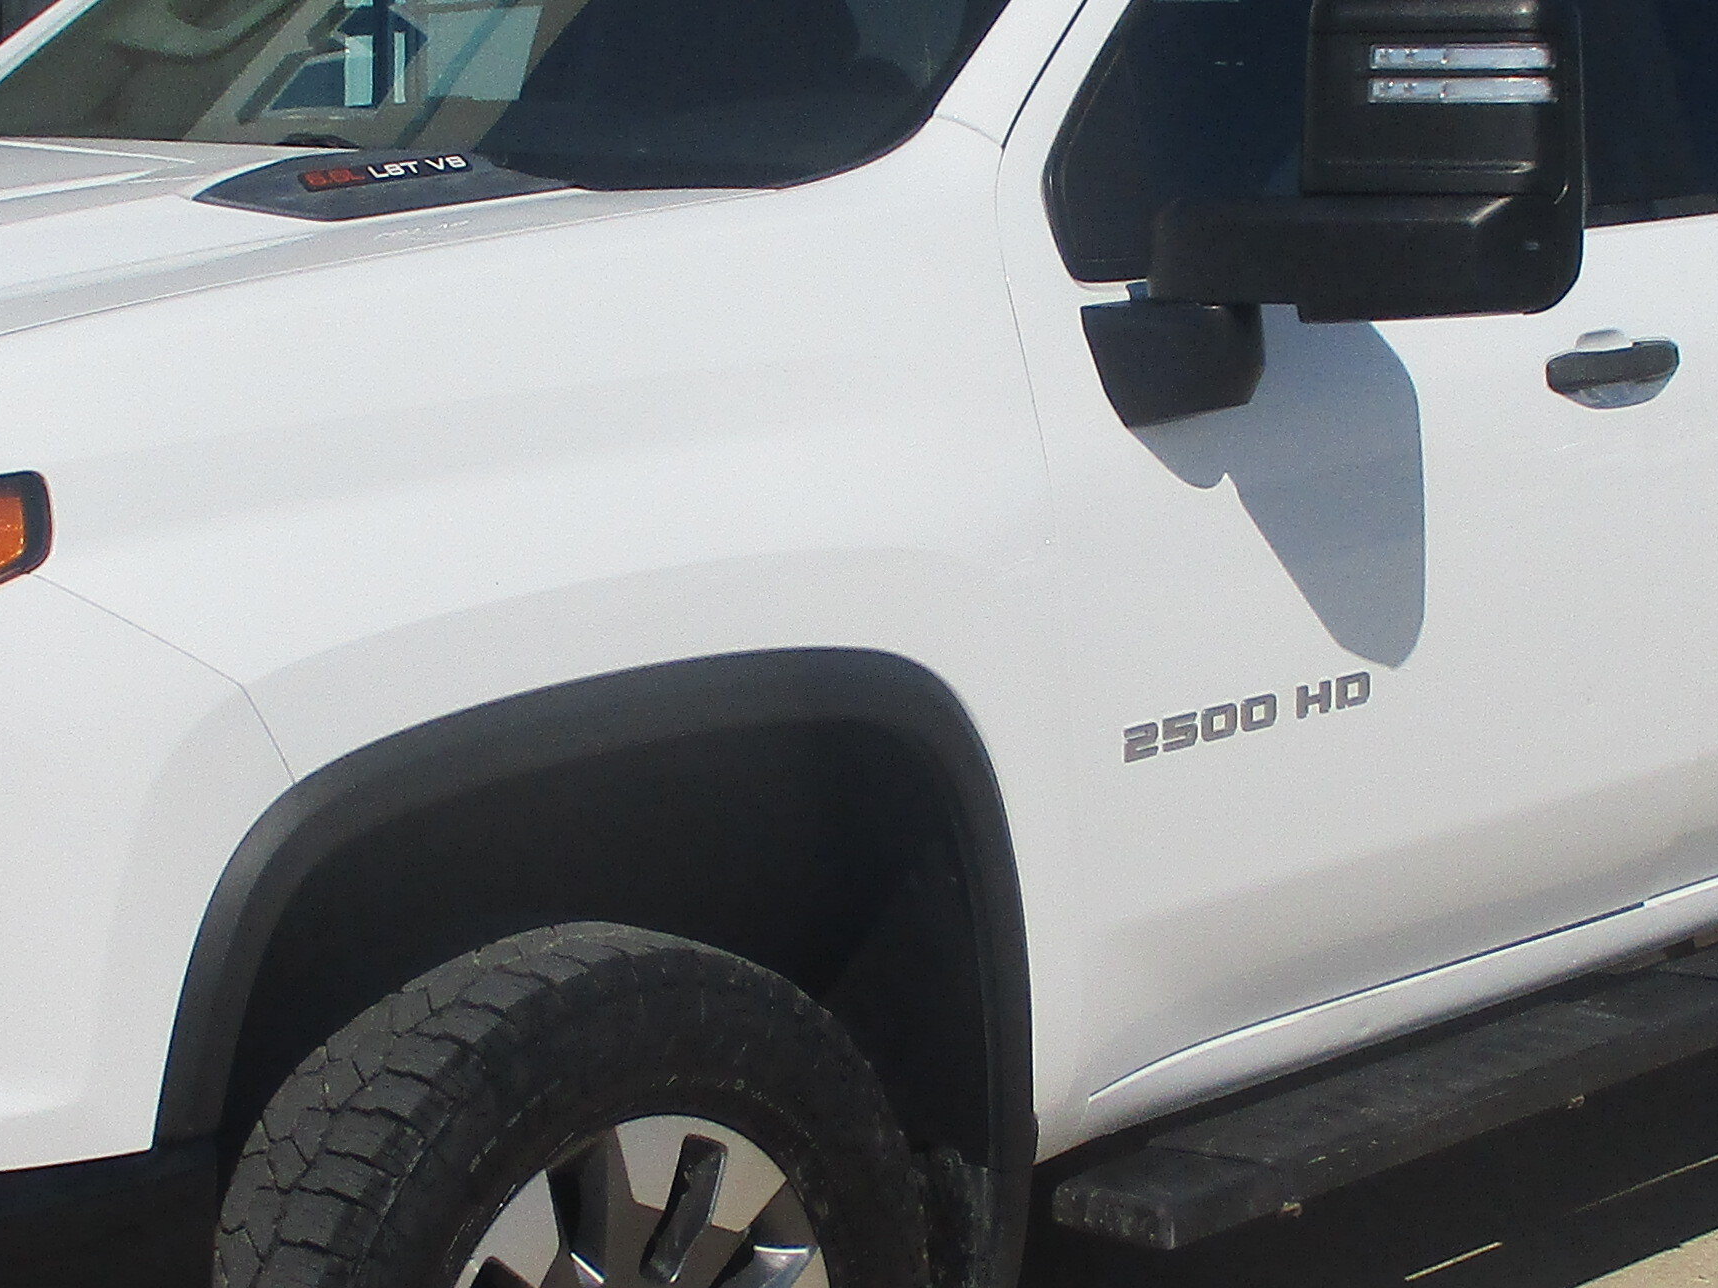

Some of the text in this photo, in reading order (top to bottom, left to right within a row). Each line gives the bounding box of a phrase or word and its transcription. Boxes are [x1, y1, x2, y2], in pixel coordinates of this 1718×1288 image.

[425, 154, 468, 171] V8
[1123, 671, 1371, 763] 2500 HD
